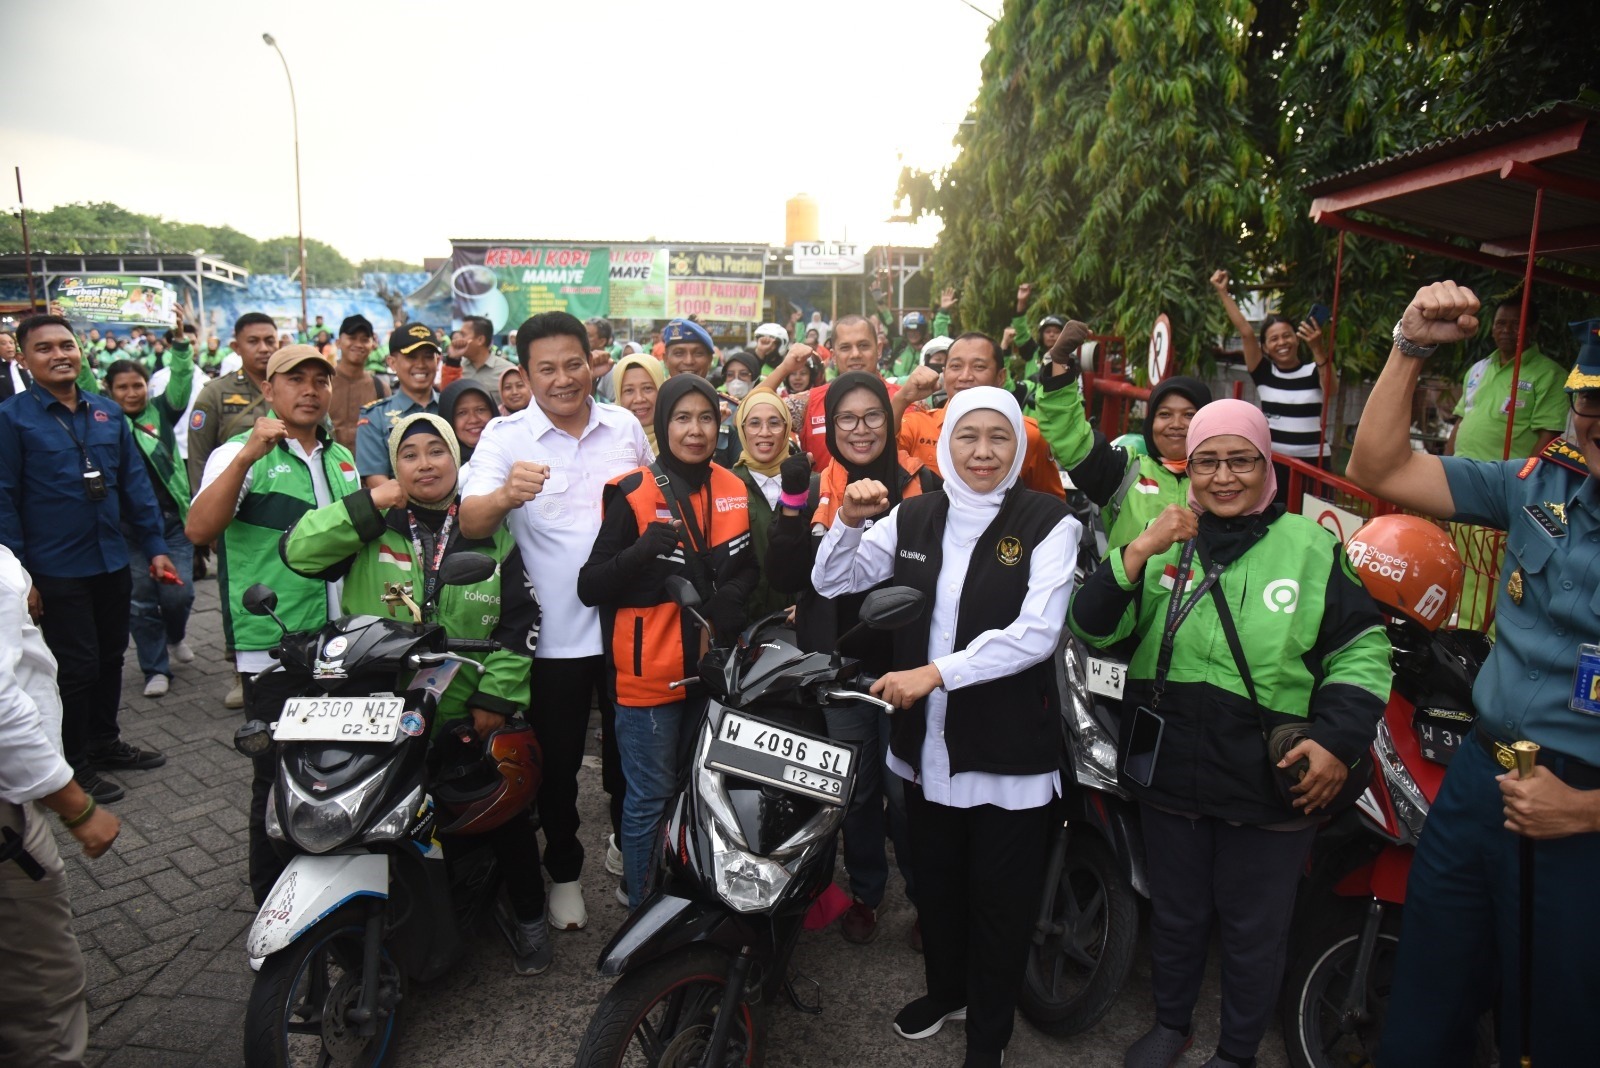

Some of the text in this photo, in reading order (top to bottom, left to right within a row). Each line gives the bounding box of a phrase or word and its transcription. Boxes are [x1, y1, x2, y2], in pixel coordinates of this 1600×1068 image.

[485, 248, 591, 268] KEDAI KOPI
[624, 251, 654, 264] KOPI
[801, 245, 856, 256] TOILET
[87, 278, 118, 286] KUPON
[522, 269, 584, 284] MAMAYE
[66, 288, 128, 298] Berbagi BBM
[676, 282, 706, 296] BIBIT
[710, 284, 758, 298] PARFUM
[76, 295, 118, 305] GRATIS
[676, 300, 710, 314] 1000
[1543, 440, 1566, 456] TNI
[1532, 509, 1556, 531] GUGUS
[1366, 546, 1408, 568] Shopee
[1360, 555, 1406, 582] Food
[1092, 662, 1126, 680] W 5
[286, 702, 300, 717] W
[363, 702, 398, 718] NAZ
[1421, 724, 1434, 742] W
[726, 720, 842, 774] W 4096 SL
[792, 770, 840, 792] 12.29
[410, 812, 434, 836] HONDA
